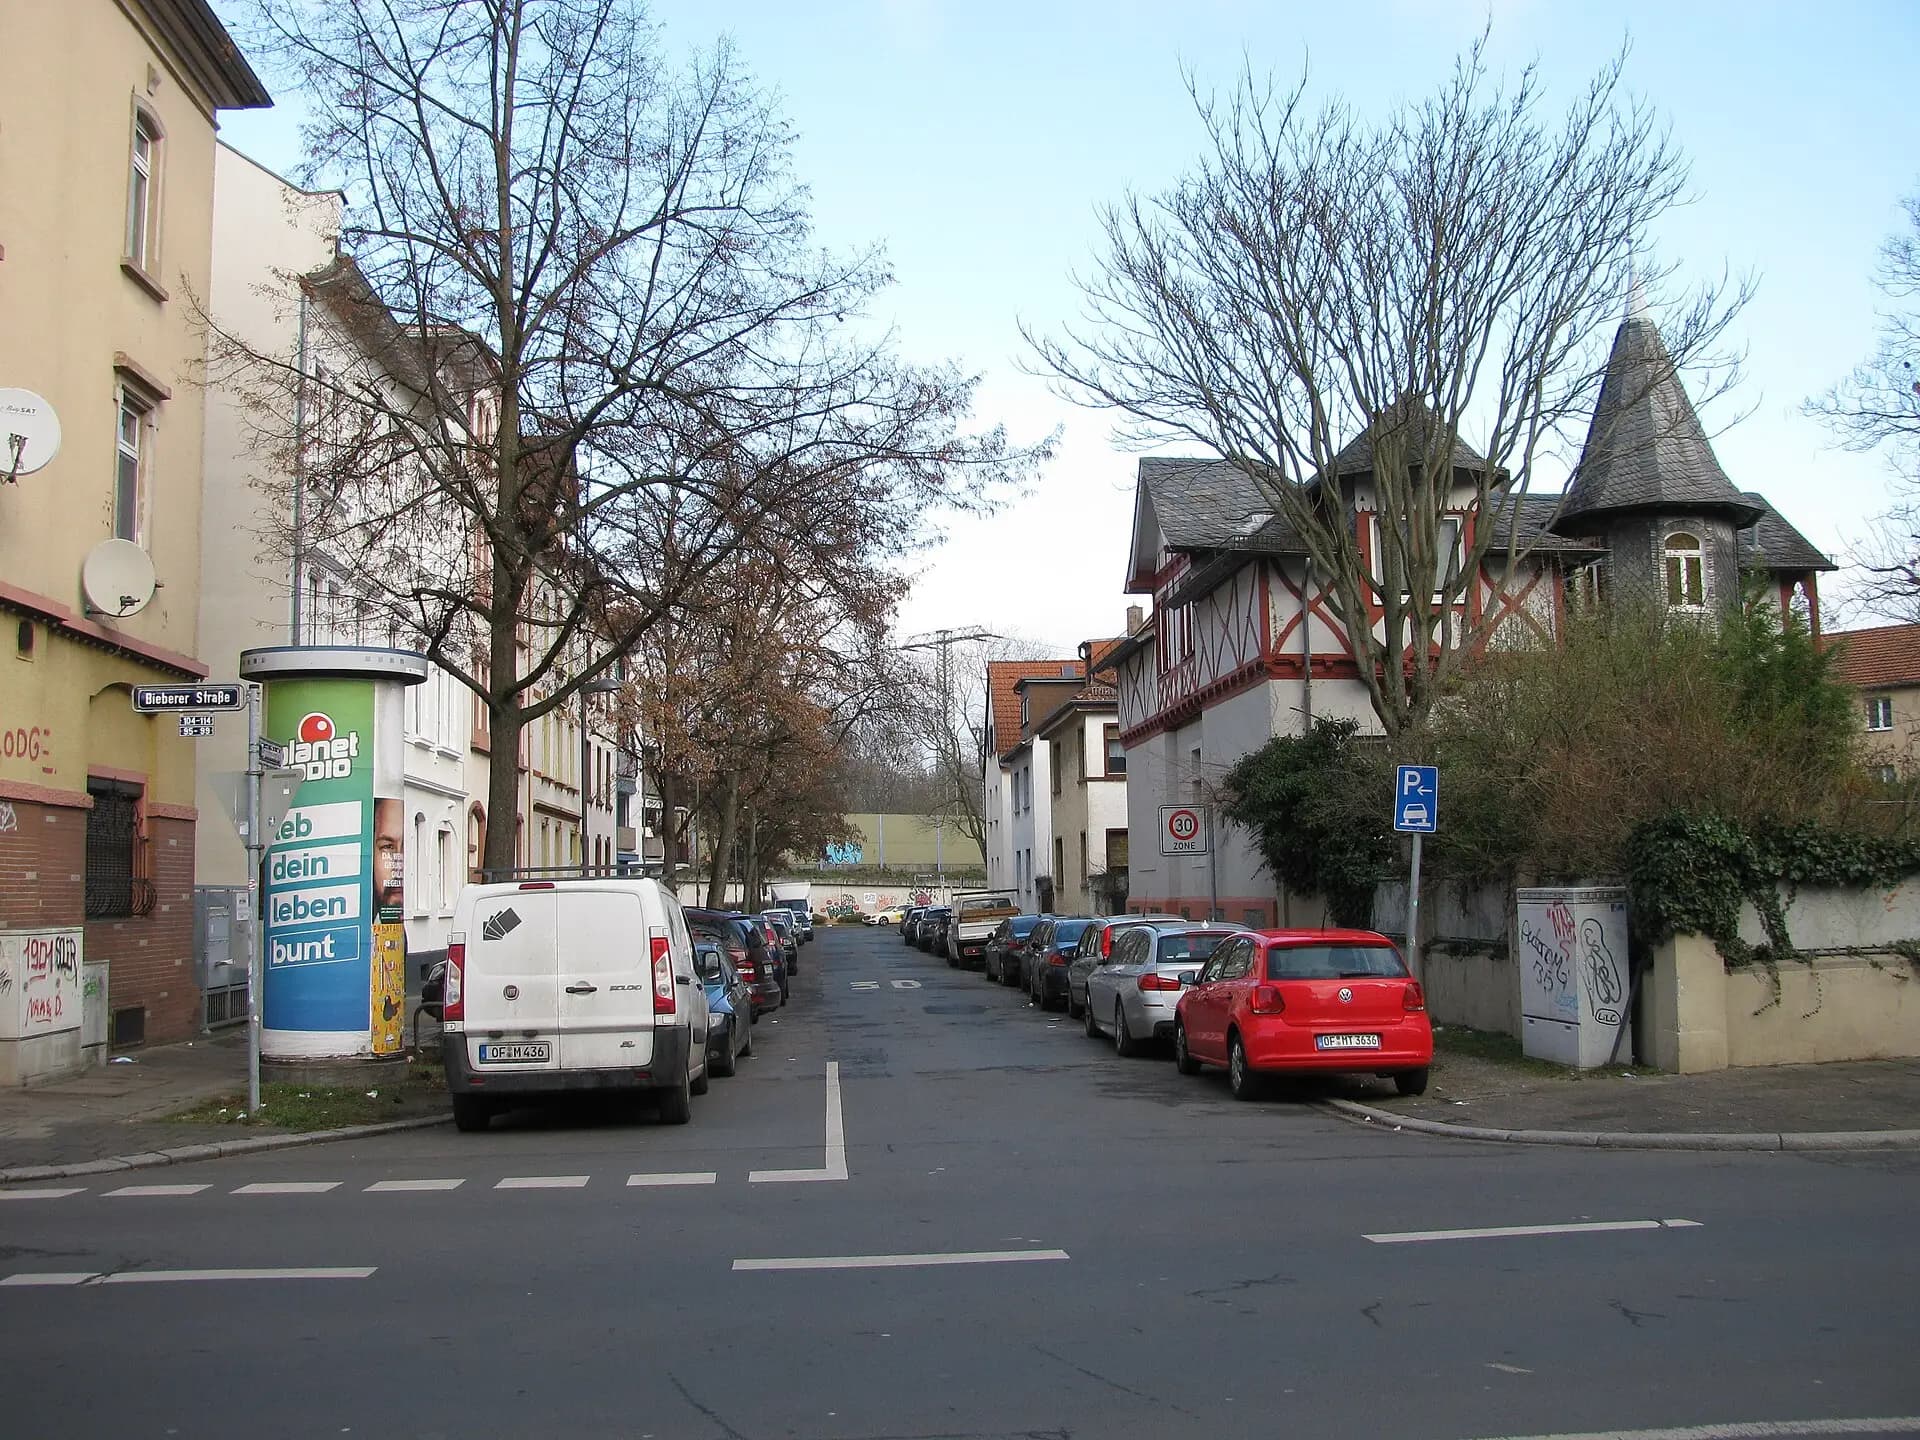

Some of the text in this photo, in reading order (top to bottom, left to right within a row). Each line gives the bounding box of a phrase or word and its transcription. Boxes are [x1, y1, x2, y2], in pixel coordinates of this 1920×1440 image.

[145, 690, 230, 705] Bieberer Straße
[183, 717, 211, 726] 104-114
[1403, 770, 1421, 796] P
[275, 812, 313, 841] eb
[1175, 818, 1193, 832] 30
[1173, 841, 1196, 850] ZONE
[273, 852, 329, 880] dein
[273, 895, 347, 922] leben
[273, 934, 336, 964] bunt
[1323, 1036, 1335, 1046] OF
[491, 1047, 506, 1058] OF
